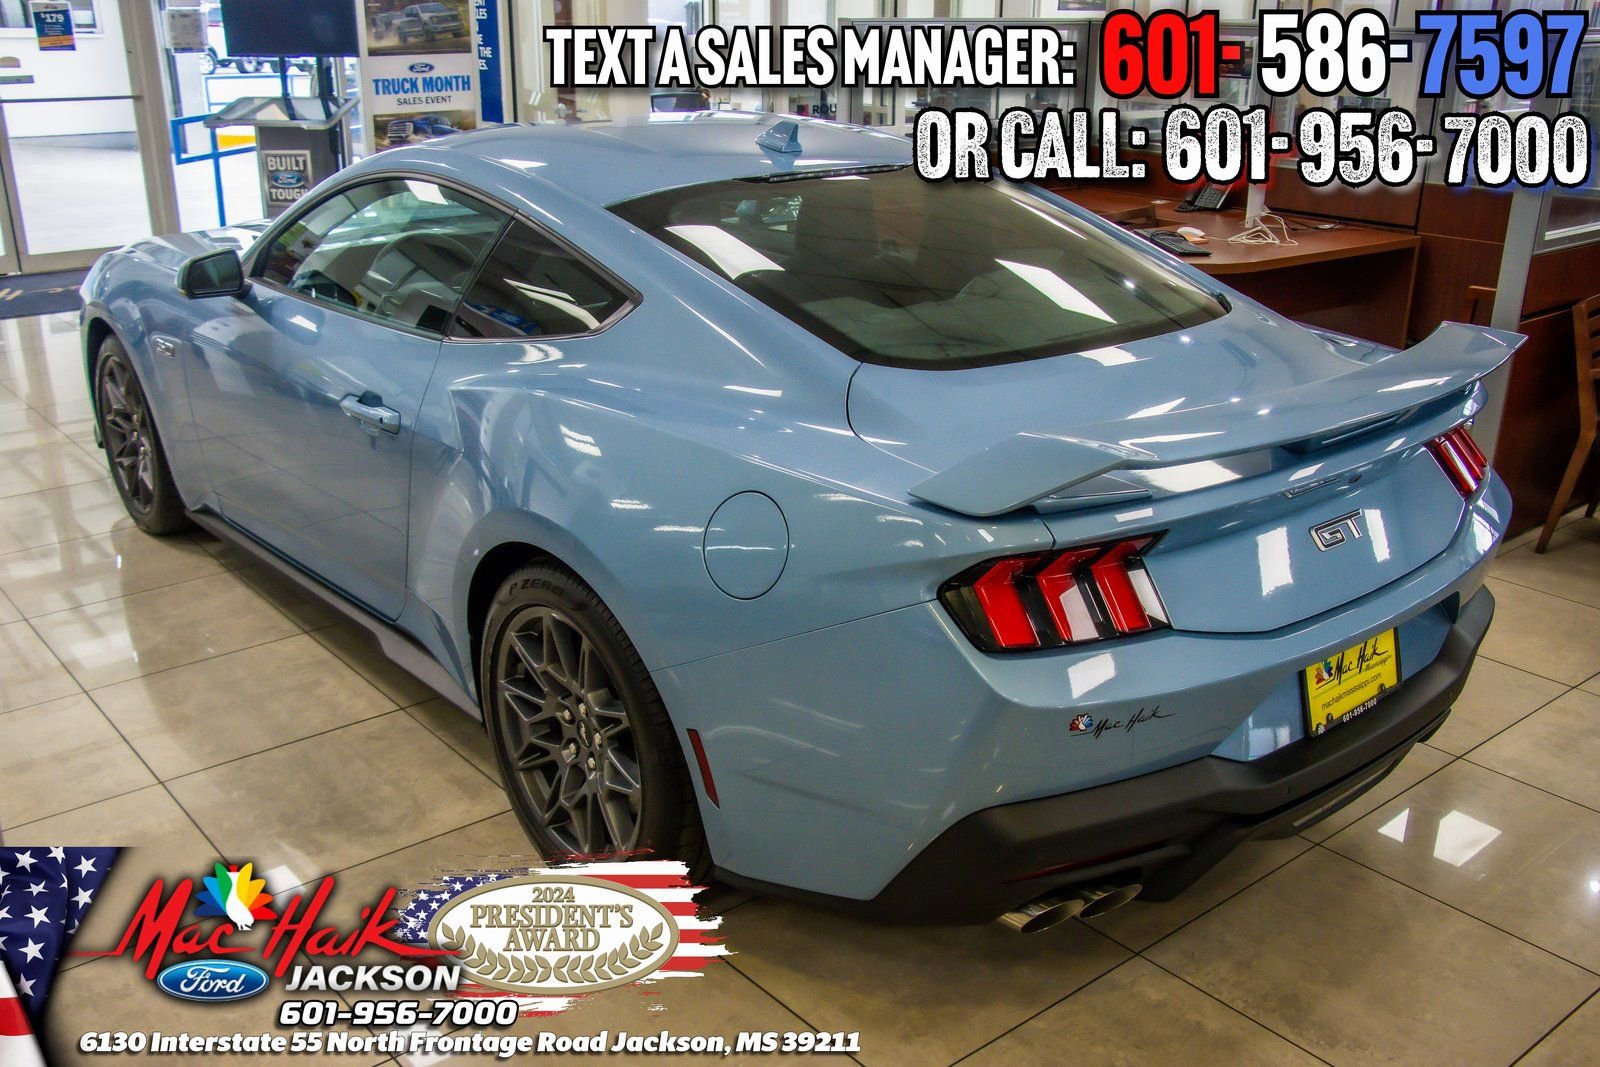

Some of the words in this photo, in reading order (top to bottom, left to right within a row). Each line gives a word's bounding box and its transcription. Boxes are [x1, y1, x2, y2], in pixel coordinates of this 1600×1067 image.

[372, 77, 420, 96] TRUCK
[422, 74, 472, 93] MONTH
[396, 97, 423, 106] SALES
[425, 95, 453, 105] EVENT
[267, 156, 305, 171] BUILT
[1309, 508, 1363, 552] GT
[1356, 637, 1389, 675] Haik
[1124, 704, 1176, 733] Haik
